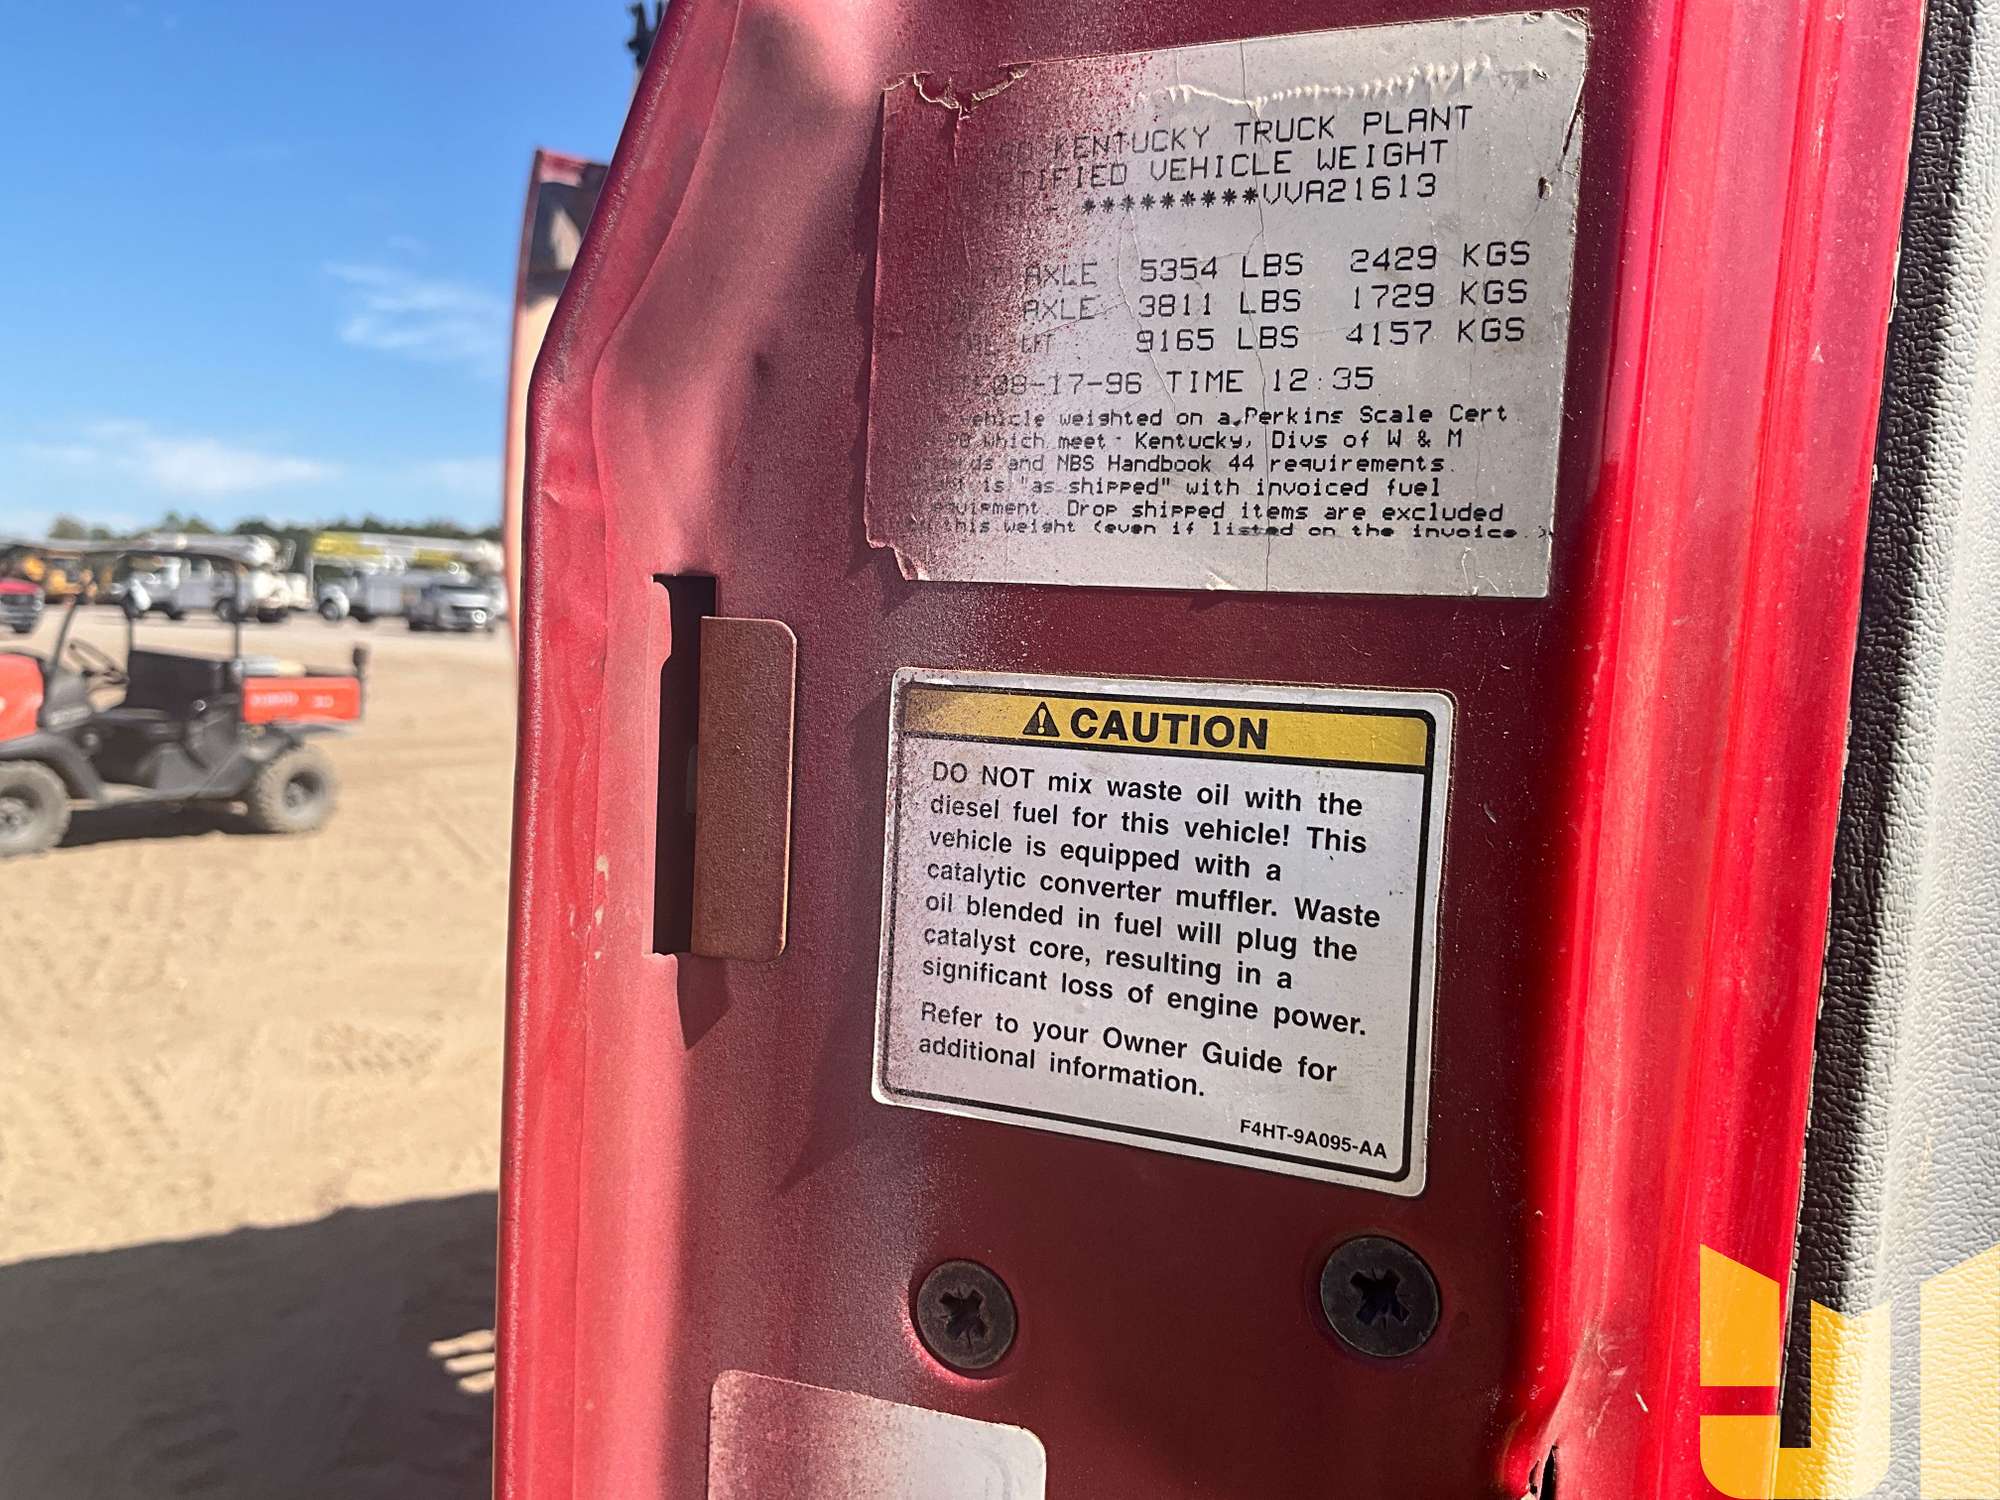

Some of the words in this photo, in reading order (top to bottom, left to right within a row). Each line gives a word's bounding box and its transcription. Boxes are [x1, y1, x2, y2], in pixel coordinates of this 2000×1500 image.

[1053, 128, 1209, 159] KENTUCKY
[1234, 115, 1335, 145] TRUCK
[1363, 105, 1472, 135] PLANT
[1149, 150, 1292, 181] VEHICLE
[1316, 139, 1448, 171] WEIGHT
[1024, 260, 1098, 286] AXLE
[1139, 255, 1217, 280] 5354
[1241, 252, 1304, 278] LBS
[1350, 245, 1437, 273] 2429
[1463, 241, 1530, 267] KGS
[1023, 297, 1096, 320] AXLE
[1137, 292, 1211, 317] 3811
[1239, 289, 1301, 314] LBS
[1353, 283, 1435, 310] 1729
[1461, 279, 1528, 305] KGS
[1135, 328, 1214, 352] 9165
[1238, 326, 1299, 350] LBS
[1346, 320, 1432, 345] 4157
[1457, 317, 1526, 343] KGS
[1165, 369, 1244, 393] TIME
[1273, 367, 1374, 392] 12:35
[1059, 409, 1162, 426] weighted
[1176, 412, 1203, 425] on
[1218, 412, 1230, 425] a
[1245, 407, 1344, 425] Perkins
[1360, 405, 1433, 423] Scale
[1450, 404, 1507, 422] Cert
[982, 433, 1045, 450] which
[1135, 432, 1251, 449] Kentucky,
[1272, 430, 1328, 448] Divs
[1344, 429, 1369, 447] of
[1387, 429, 1401, 447] W
[1418, 430, 1431, 447] &
[1448, 428, 1462, 447] M
[1007, 457, 1044, 471] and
[1057, 455, 1094, 472] NBS
[1108, 455, 1212, 472] Handbook
[1229, 455, 1254, 472] 44
[984, 478, 1004, 493] is
[1069, 478, 1170, 495] shipped"
[1187, 478, 1239, 495] with
[1257, 478, 1369, 496] invoiced
[1387, 477, 1439, 496] fuel
[1004, 520, 1076, 533] weight
[1173, 521, 1194, 535] if
[1213, 522, 1293, 536] listed
[1308, 527, 1336, 536] on
[1352, 523, 1394, 537] the
[1067, 500, 1118, 517] Drop
[1132, 501, 1224, 519] shipped
[1242, 501, 1308, 519] items
[1324, 506, 1366, 520] are
[1382, 503, 1503, 521] excluded
[1070, 708, 1268, 750] CAUTION
[930, 760, 969, 783] DO
[981, 763, 1035, 789] NOT
[1046, 771, 1093, 795] mix
[1106, 777, 1183, 803] waste
[1195, 784, 1230, 808] oil
[1244, 788, 1302, 812] with
[1317, 792, 1364, 817] the
[930, 794, 1000, 819] diesel
[1013, 801, 1059, 825] fuel
[1072, 806, 1109, 829] for
[1121, 810, 1170, 835] this
[1183, 817, 1290, 846] vehicle!
[1306, 825, 1368, 853] This
[929, 828, 1013, 854] vehicle
[1026, 834, 1047, 857] is
[1060, 841, 1181, 872] equipped
[1194, 852, 1251, 879] with
[1265, 862, 1282, 881] a
[926, 861, 1027, 890] catalytic
[1039, 873, 1163, 903] converter
[1175, 887, 1278, 917] muffler.
[1294, 895, 1382, 928] Waste
[924, 892, 953, 914] oil
[966, 897, 1064, 925] blended
[1077, 909, 1101, 930] in
[1114, 912, 1163, 938] fuel
[1177, 919, 1222, 945] will
[1236, 926, 1297, 960] plug
[1312, 936, 1359, 961] the
[923, 925, 1017, 954] catalyst
[1029, 940, 1091, 965] core,
[1105, 945, 1222, 984] resulting
[1236, 963, 1262, 985] in
[1275, 970, 1293, 989] a
[921, 957, 1049, 991] significant
[1060, 973, 1114, 999] loss
[1127, 979, 1154, 1004] of
[1167, 989, 1259, 1022] engine
[1273, 1004, 1368, 1035] power.
[920, 1001, 983, 1029] Refer
[995, 1009, 1020, 1034] to
[1031, 1020, 1090, 1045] your
[1101, 1026, 1188, 1057] Owner
[1201, 1040, 1284, 1074] Guide
[1297, 1055, 1339, 1083] for
[918, 1034, 1036, 1069] additional
[1049, 1051, 1206, 1096] information.
[1240, 1119, 1386, 1157] F4HT-9A095-AA
